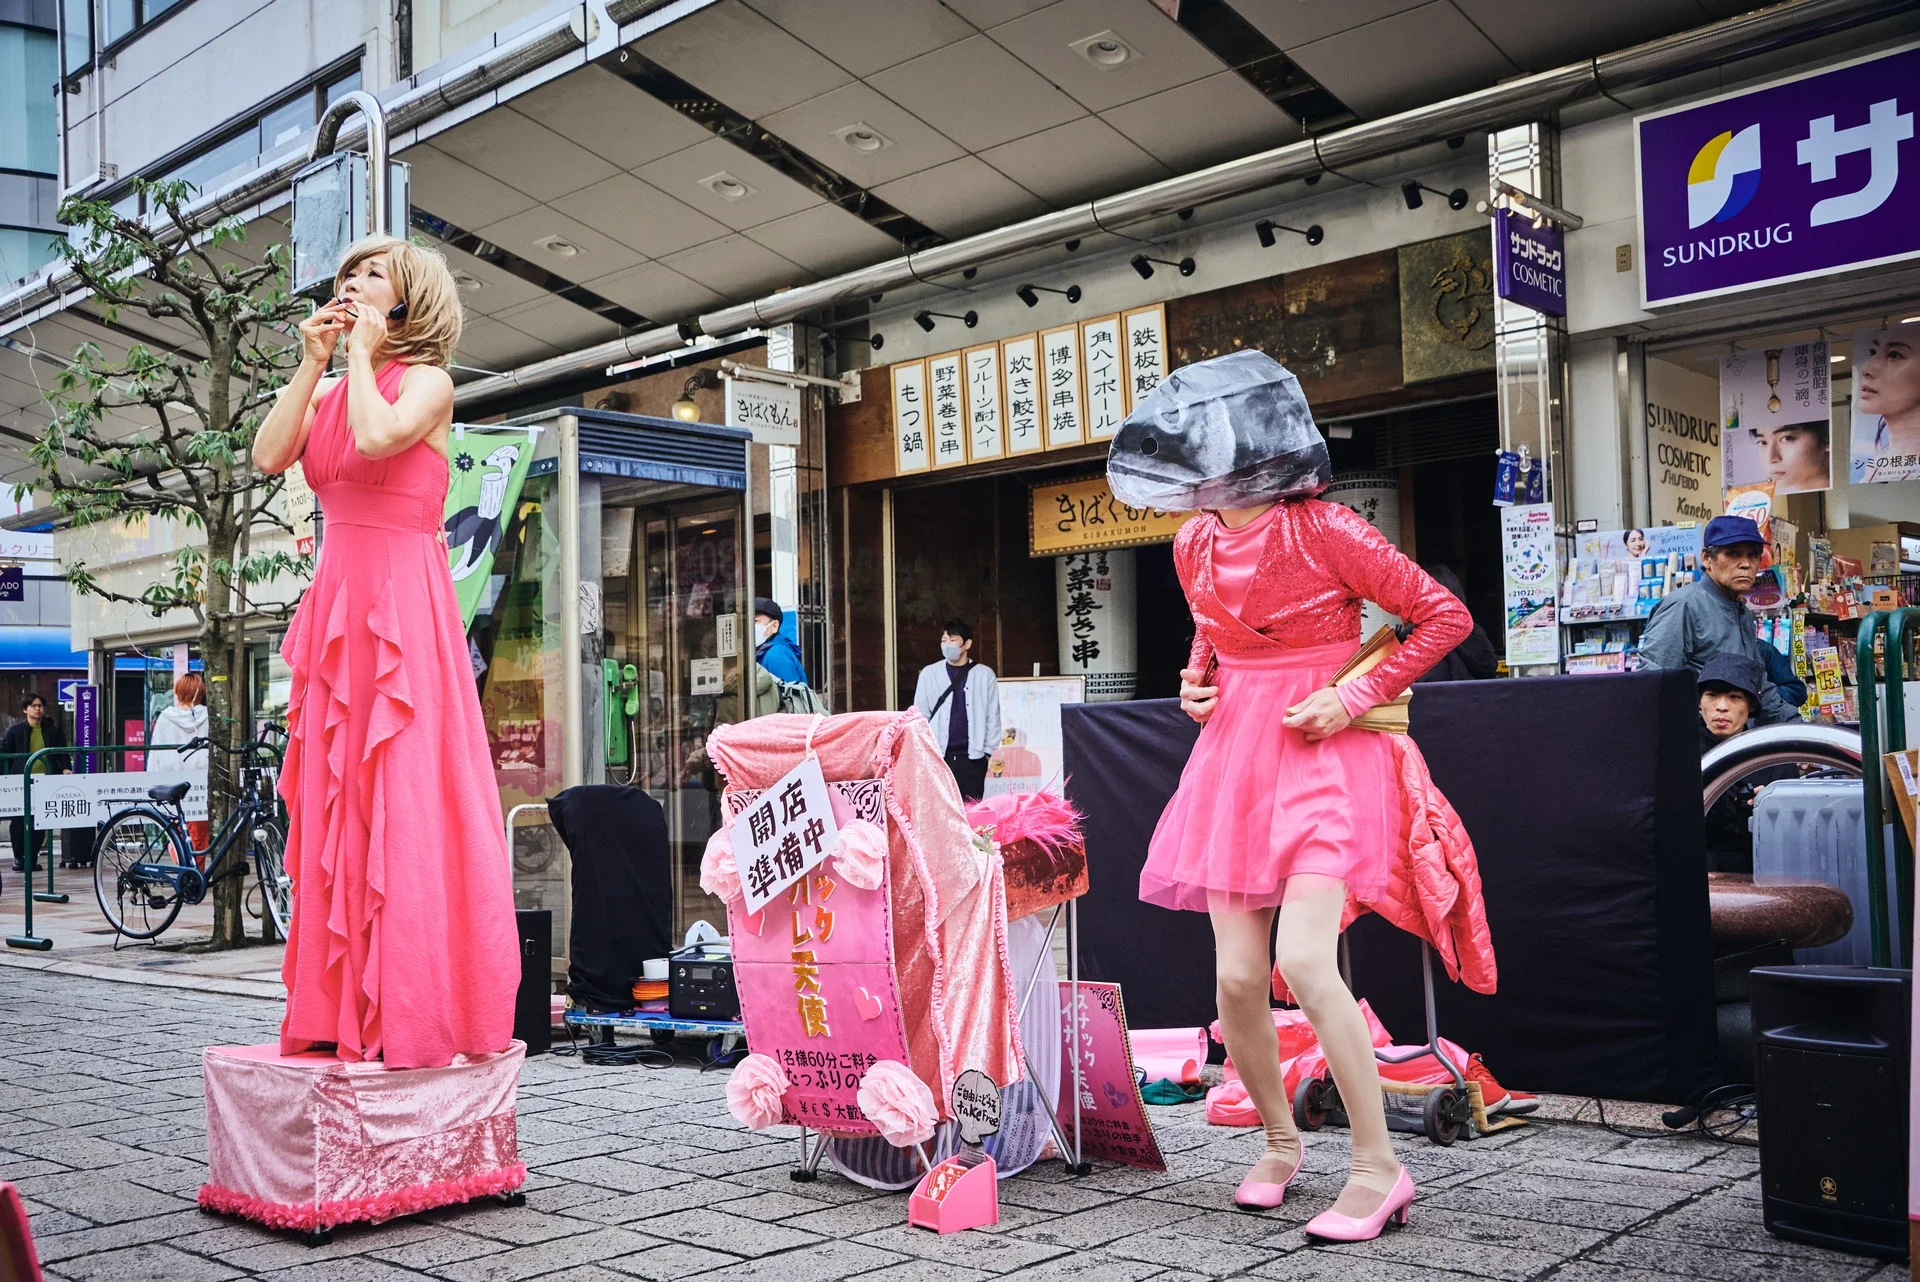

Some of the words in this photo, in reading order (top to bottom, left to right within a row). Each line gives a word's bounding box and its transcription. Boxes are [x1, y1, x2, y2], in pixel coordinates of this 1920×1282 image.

[1797, 98, 1914, 227] サ
[1663, 223, 1793, 267] SUNDRUG
[1513, 262, 1563, 297] COSMETIC
[1090, 331, 1118, 429] 角ハイボール
[1132, 327, 1161, 401] 鉄板餃
[935, 365, 960, 455] 野菜巻き串
[973, 357, 997, 449] フルーツ酎ハイ
[1009, 355, 1035, 437] 炊き餃子
[1049, 345, 1077, 431] 博多串焼
[737, 399, 793, 426] きばくもん
[901, 384, 924, 453] もつ鍋
[1647, 403, 1719, 447] SUNDRUG
[1658, 443, 1712, 477] COSMETIC
[1660, 469, 1699, 491] SHISEIDO
[1361, 497, 1380, 527] 博多
[1676, 496, 1712, 521] Kanebo
[1083, 525, 1148, 540] KIBAKUMON
[1667, 545, 1694, 553] ANESSA
[44, 799, 92, 819] 呉服町
[748, 778, 807, 848] 開店
[748, 816, 826, 899] 準備中
[1077, 993, 1096, 1067] スナック
[785, 1067, 865, 1091] たっぷりの
